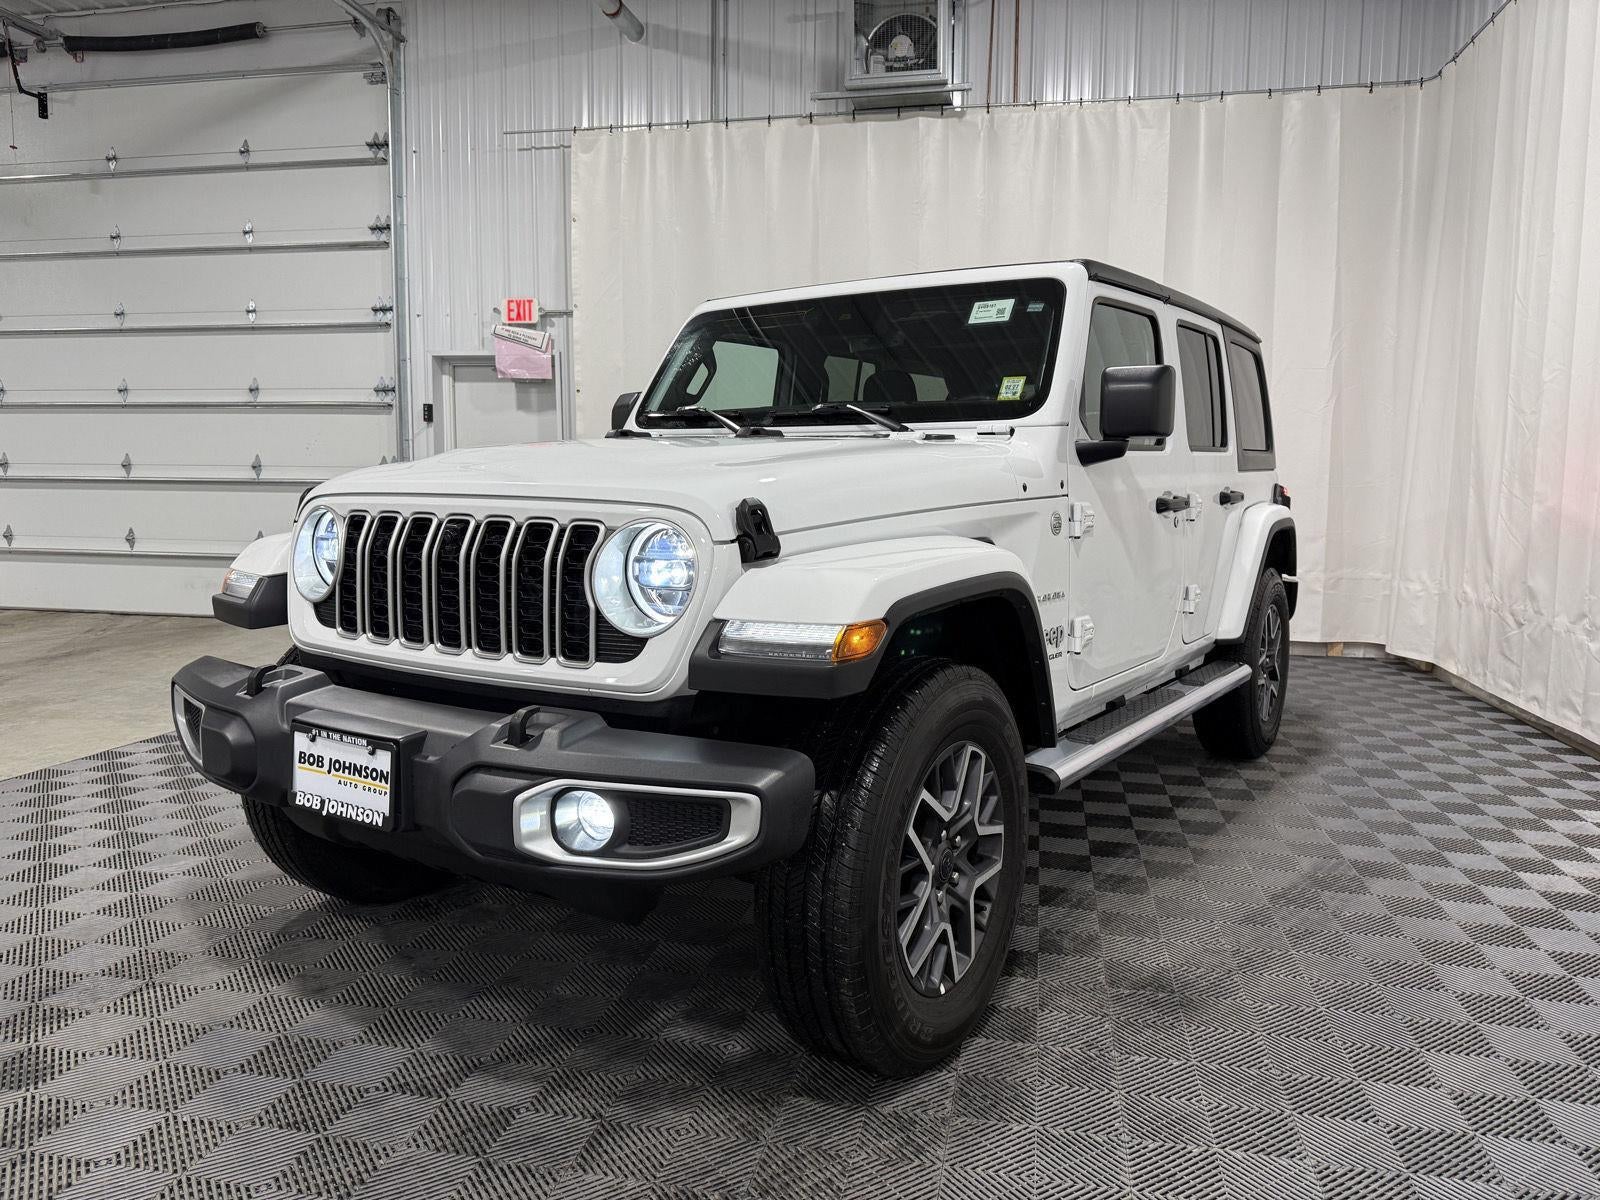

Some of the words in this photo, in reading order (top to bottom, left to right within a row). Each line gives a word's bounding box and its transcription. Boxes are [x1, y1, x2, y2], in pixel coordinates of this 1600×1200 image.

[507, 299, 534, 322] EXIT
[1048, 651, 1063, 661] GLER
[320, 730, 328, 738] IN
[328, 732, 341, 741] THE
[342, 734, 368, 747] NATION
[298, 750, 325, 769] BOB
[327, 757, 390, 785] JOHNSON
[337, 779, 359, 789] AUTO
[362, 785, 388, 797] GROUP
[295, 790, 322, 810] BOB
[321, 797, 385, 827] JOHNSON
